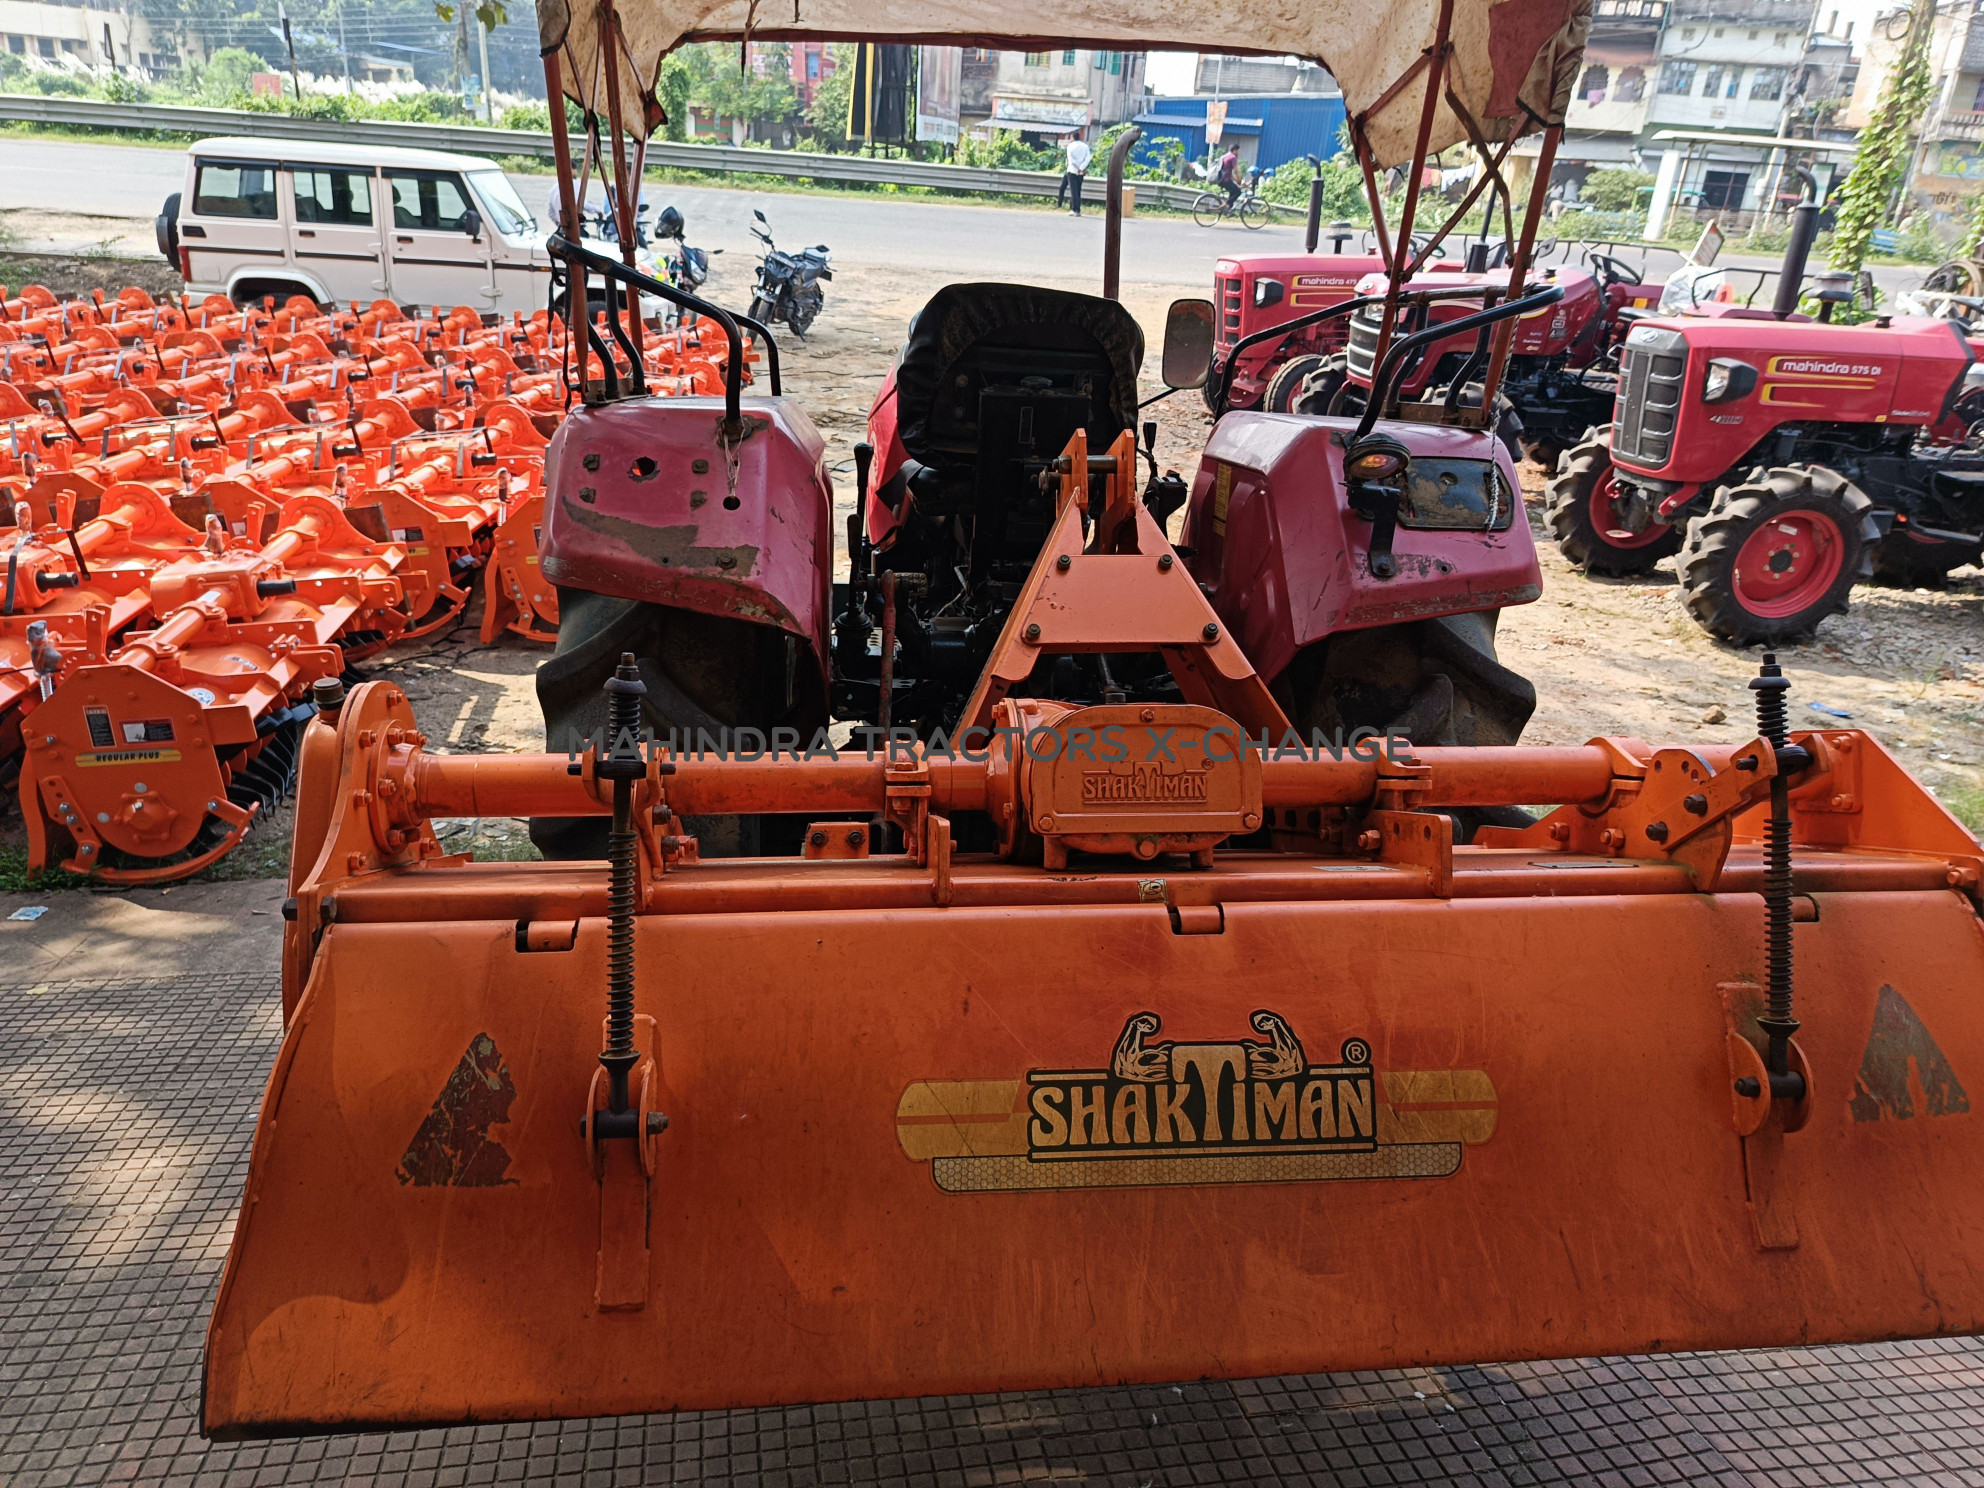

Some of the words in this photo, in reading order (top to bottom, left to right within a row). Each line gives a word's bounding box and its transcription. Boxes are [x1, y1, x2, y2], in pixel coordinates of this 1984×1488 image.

[1302, 277, 1344, 285] mahindra
[1783, 361, 1850, 374] mahindra
[1851, 365, 1869, 375] 575
[1870, 366, 1881, 375] DI
[96, 752, 136, 763] REGULAR
[138, 751, 160, 760] PLUS
[1082, 761, 1207, 800] SHAKTIMAN
[1030, 1044, 1374, 1147] SHAKTIMAN
